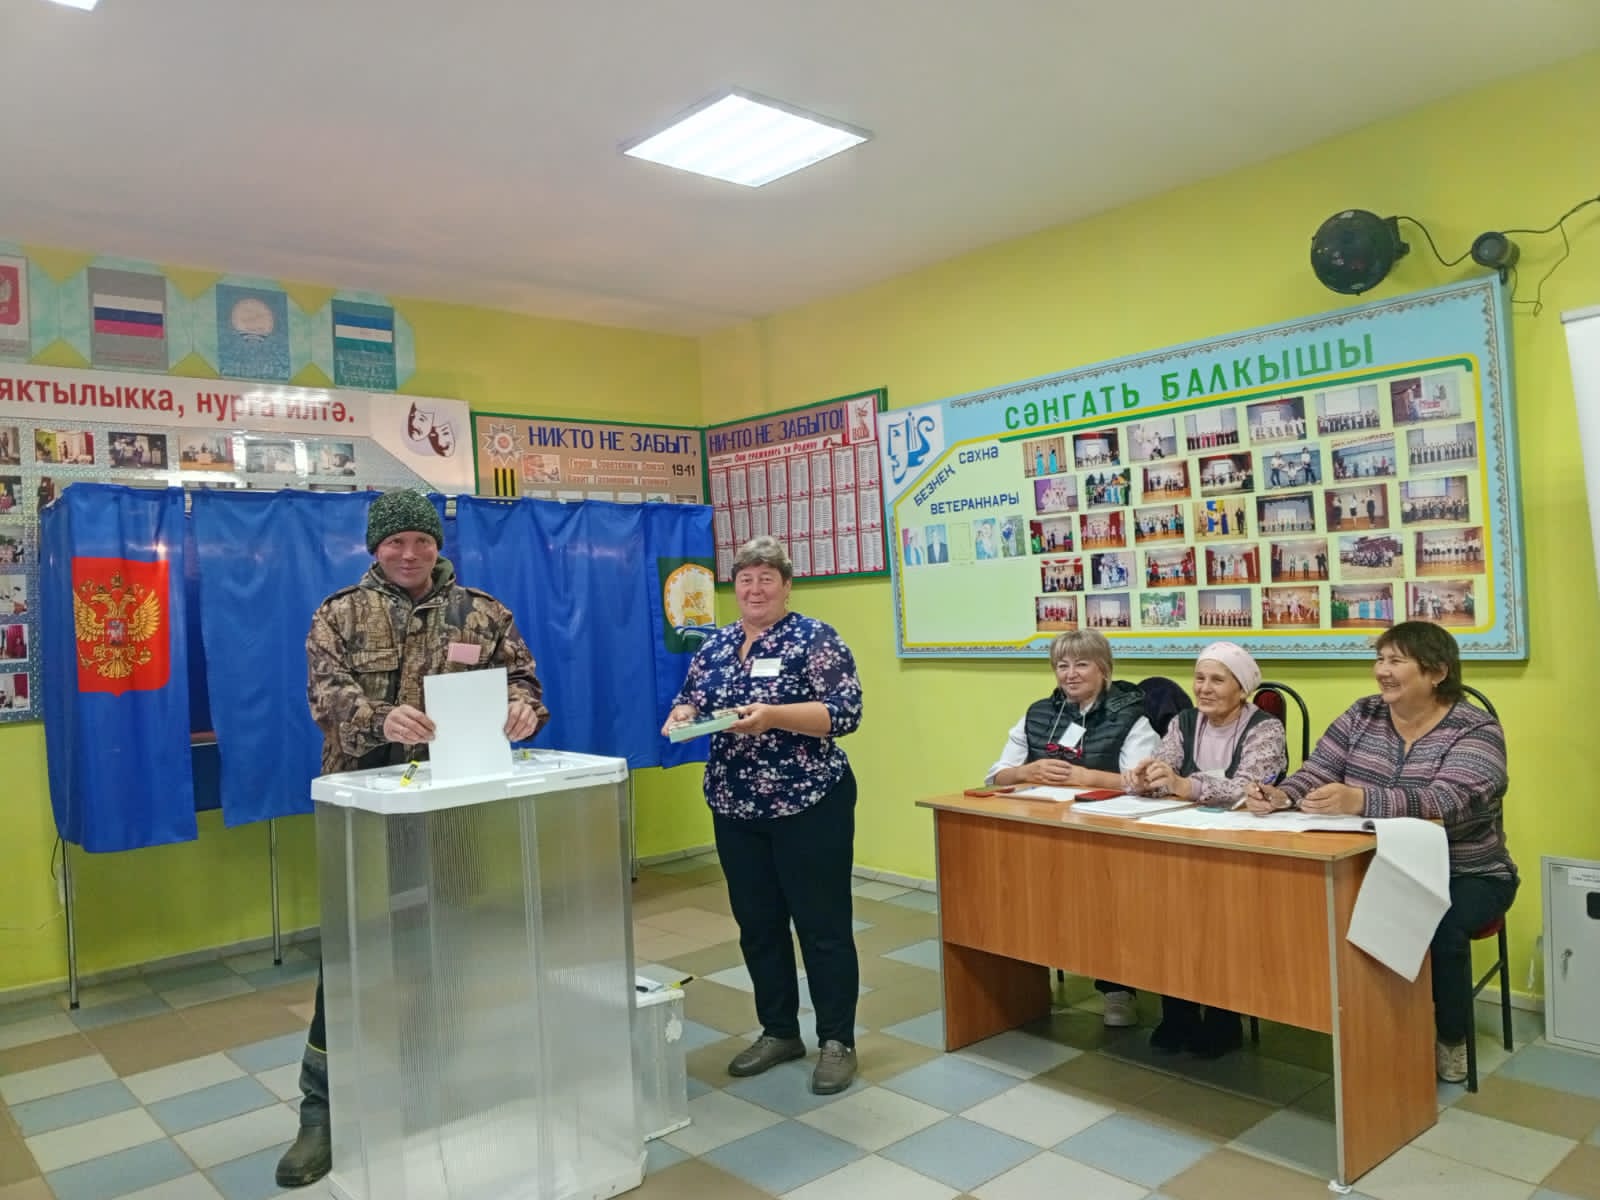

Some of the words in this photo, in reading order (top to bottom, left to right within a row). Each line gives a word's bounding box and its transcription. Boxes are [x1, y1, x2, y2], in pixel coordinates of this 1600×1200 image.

[1160, 333, 1374, 401] БАЛКЫШЫ
[528, 425, 594, 449] НИКТО
[600, 430, 625, 451] НЕ
[631, 432, 697, 456] ЗАБЫТ,
[709, 428, 751, 453] НИЧТО
[755, 423, 774, 444] НЕ
[779, 408, 844, 440] ЗАБЫТО!
[672, 463, 696, 477] 1941
[930, 492, 1019, 516] ВЕТЕРАННАРЫ
